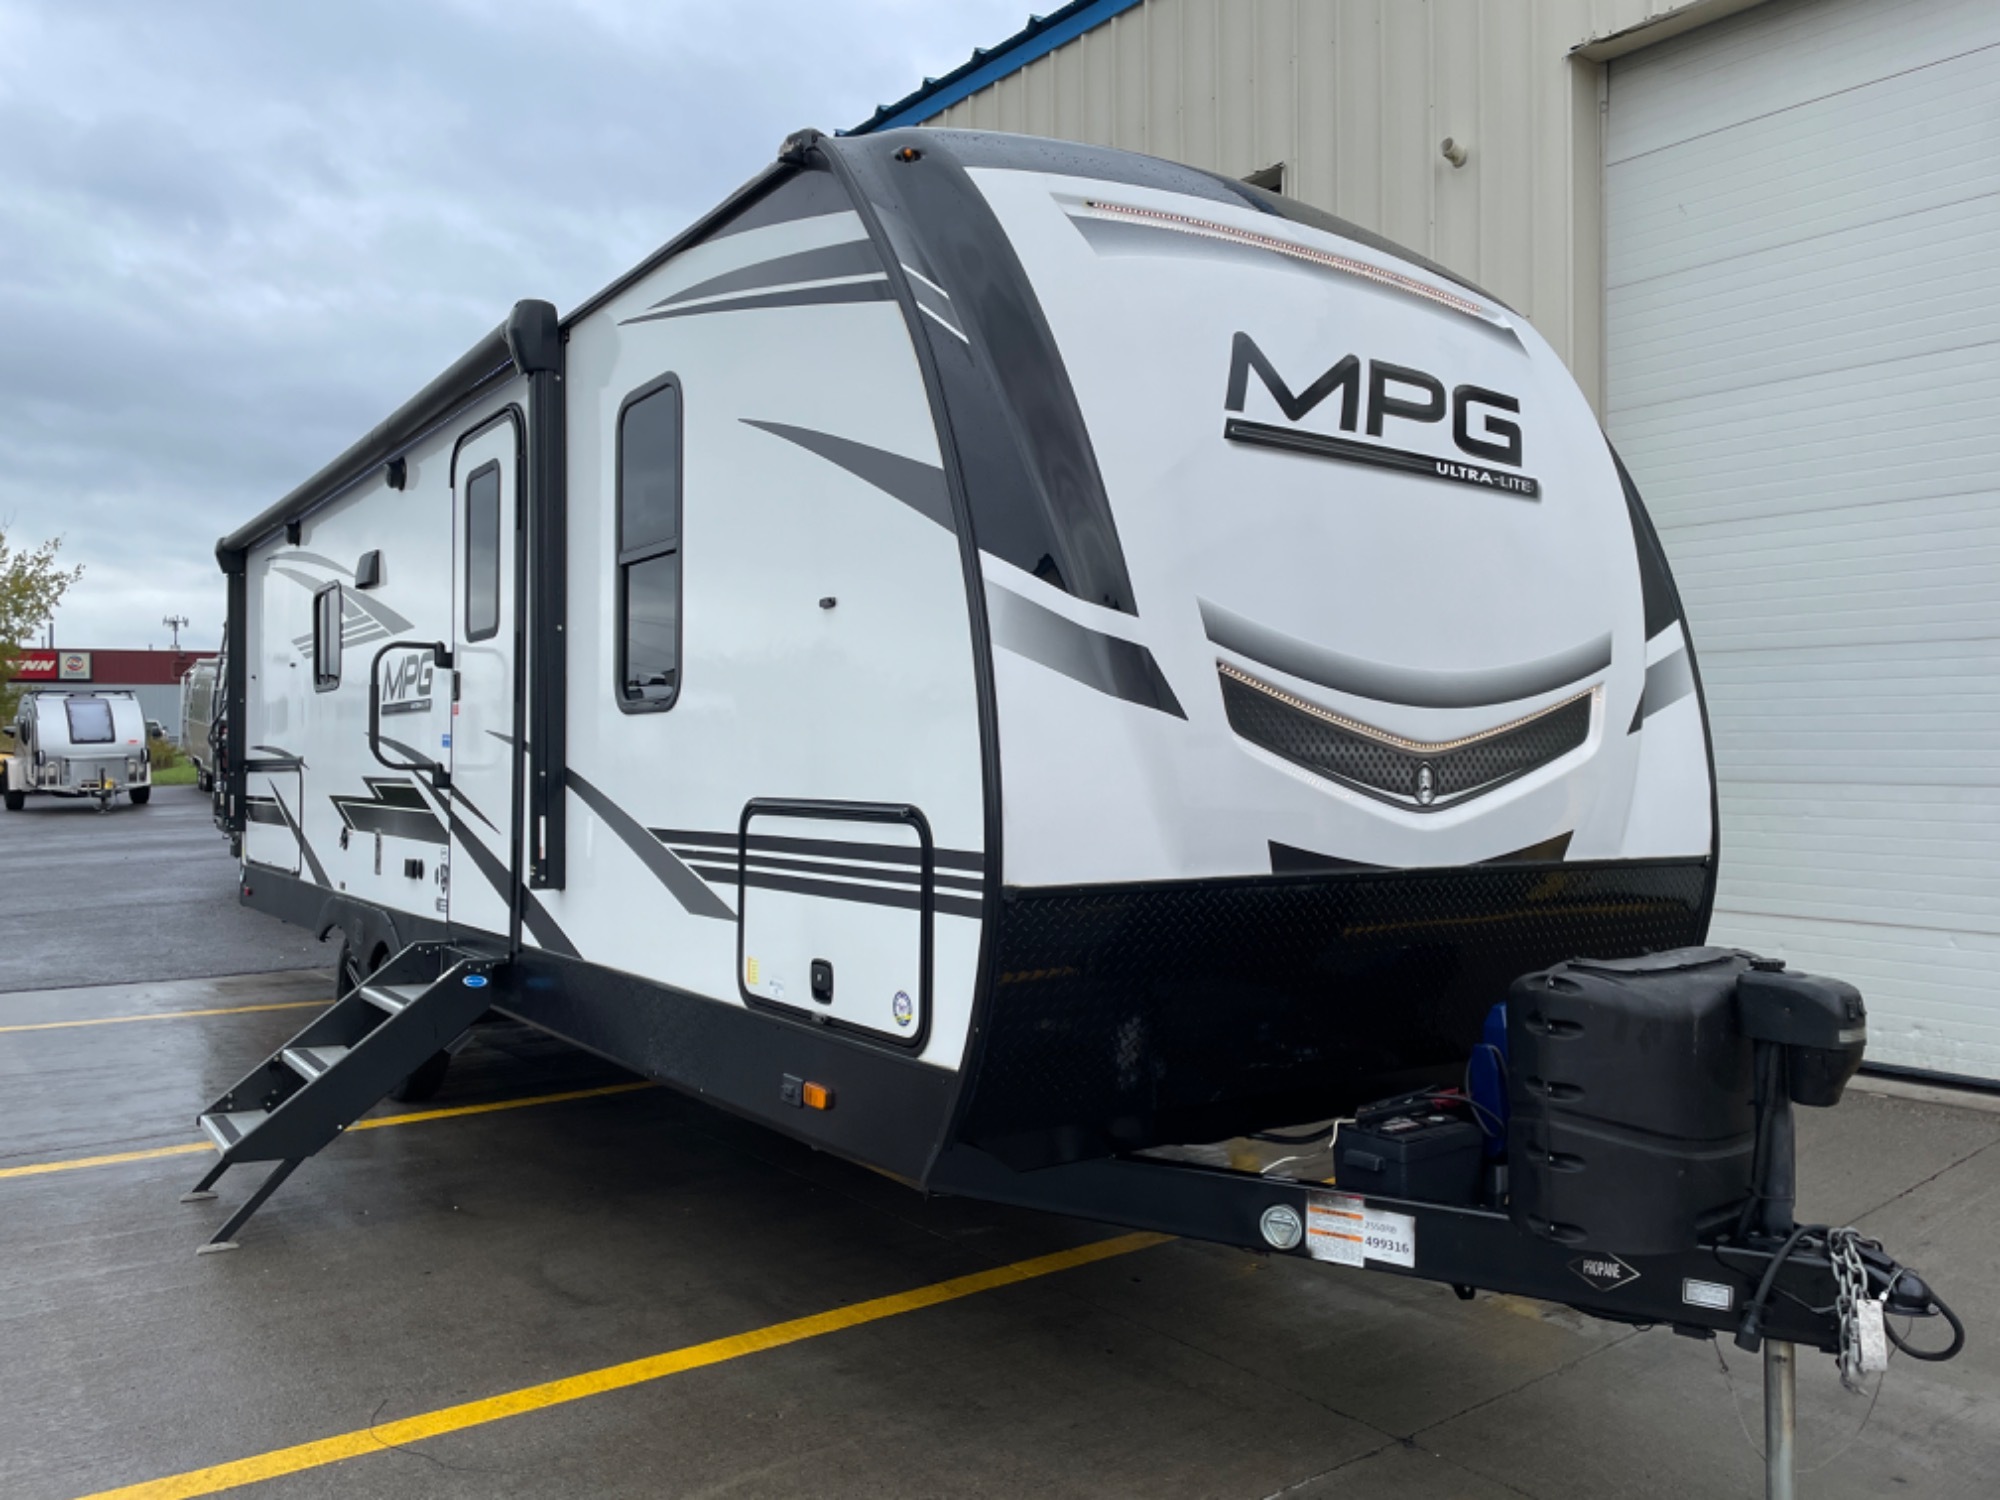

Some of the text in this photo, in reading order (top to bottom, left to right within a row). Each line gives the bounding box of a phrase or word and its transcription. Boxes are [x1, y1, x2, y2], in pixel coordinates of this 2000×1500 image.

[1224, 331, 1522, 467] MPG
[1435, 461, 1534, 493] ULTRA-LITE
[382, 650, 434, 701] MPG
[1365, 1236, 1410, 1254] 499316
[1582, 1259, 1621, 1279] PROPANE
